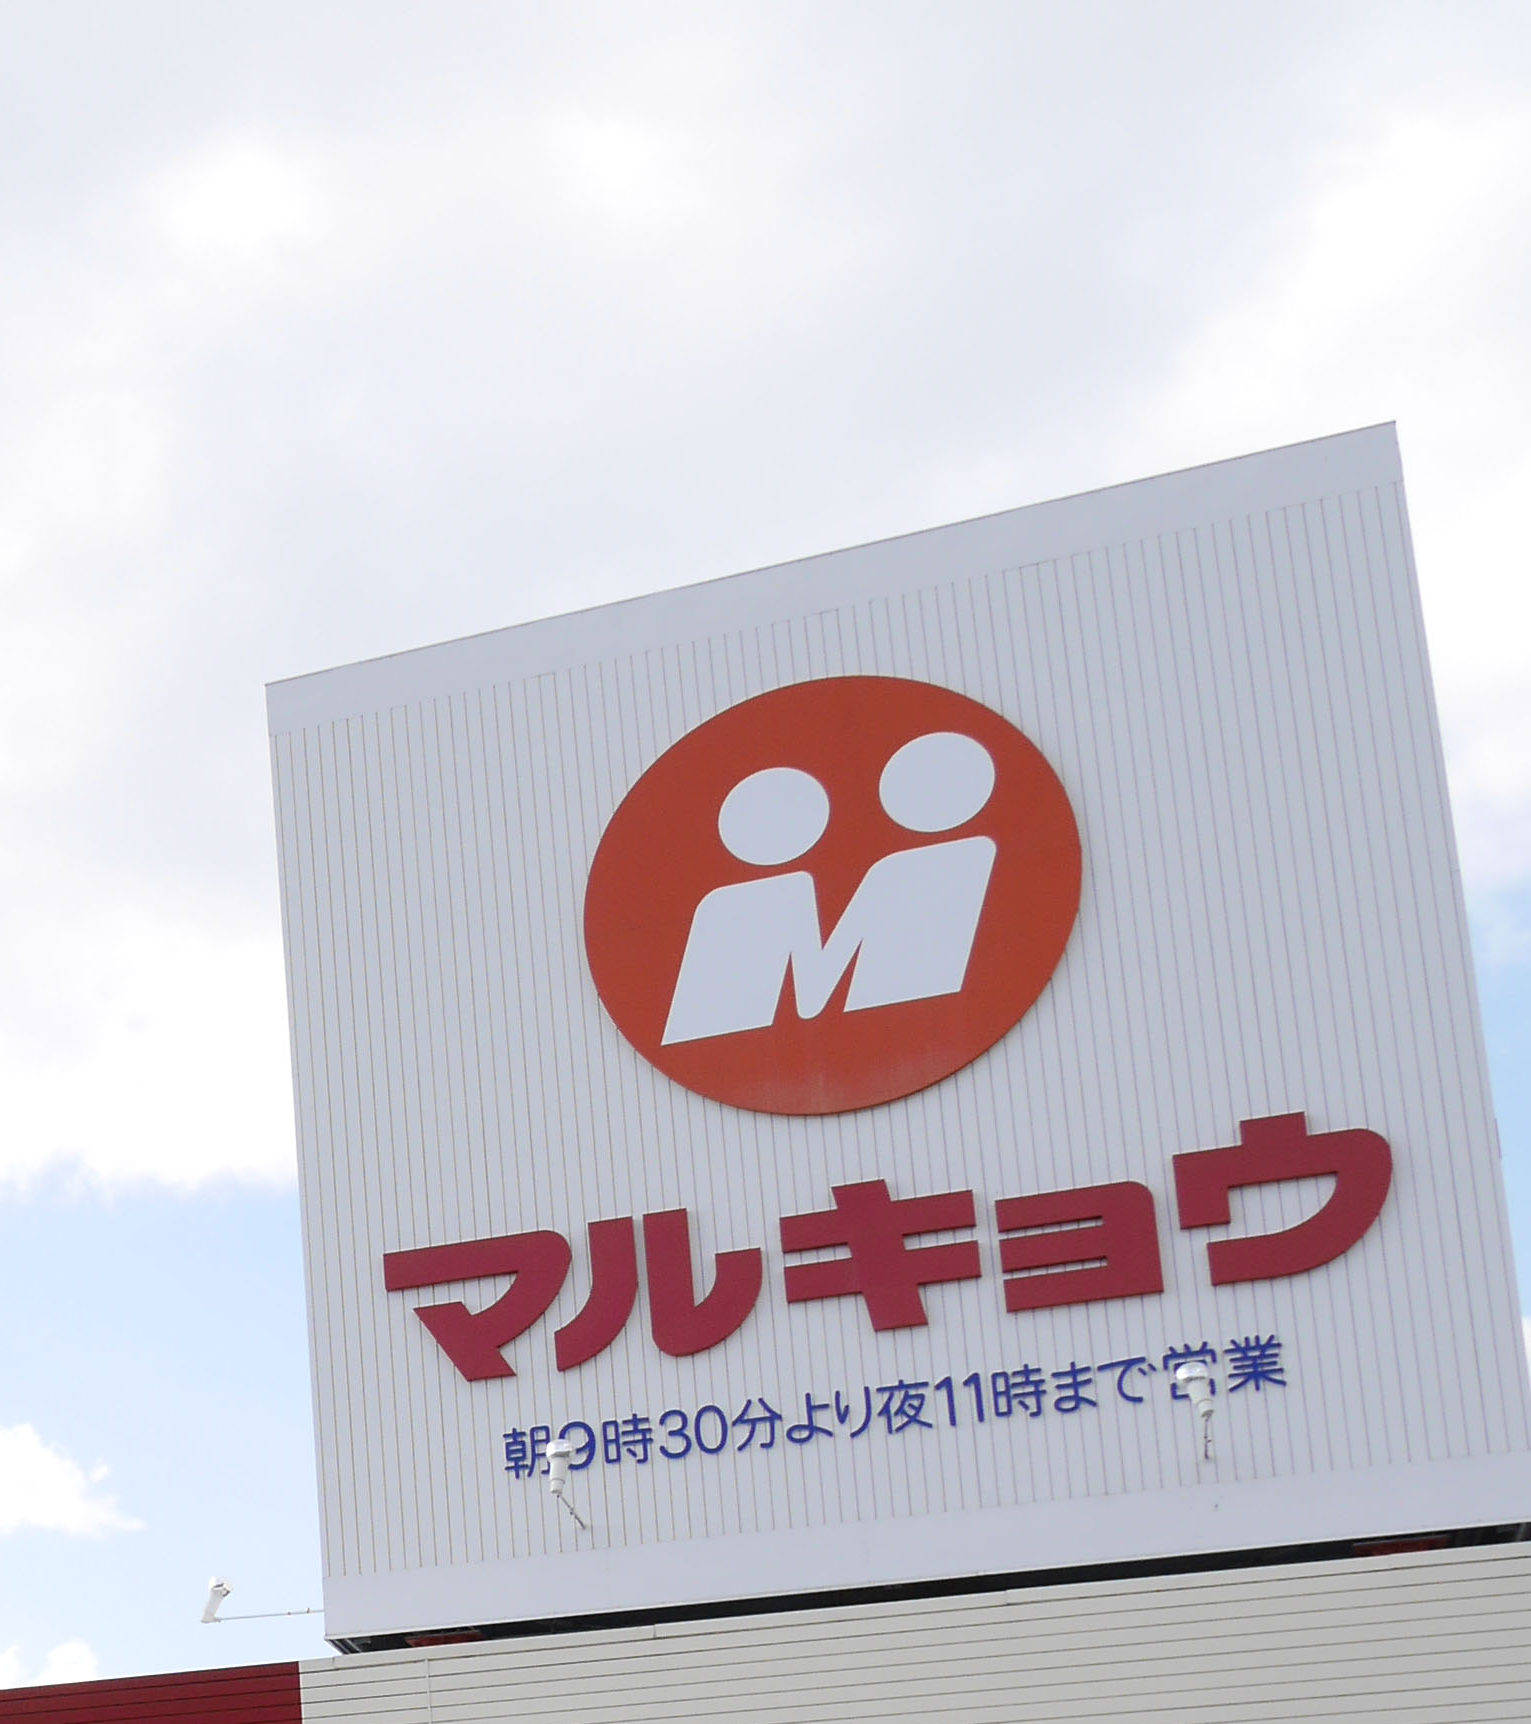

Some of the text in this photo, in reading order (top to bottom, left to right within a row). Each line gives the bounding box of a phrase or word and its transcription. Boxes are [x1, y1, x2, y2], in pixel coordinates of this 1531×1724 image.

[383, 1110, 1394, 1383] マルキョウ
